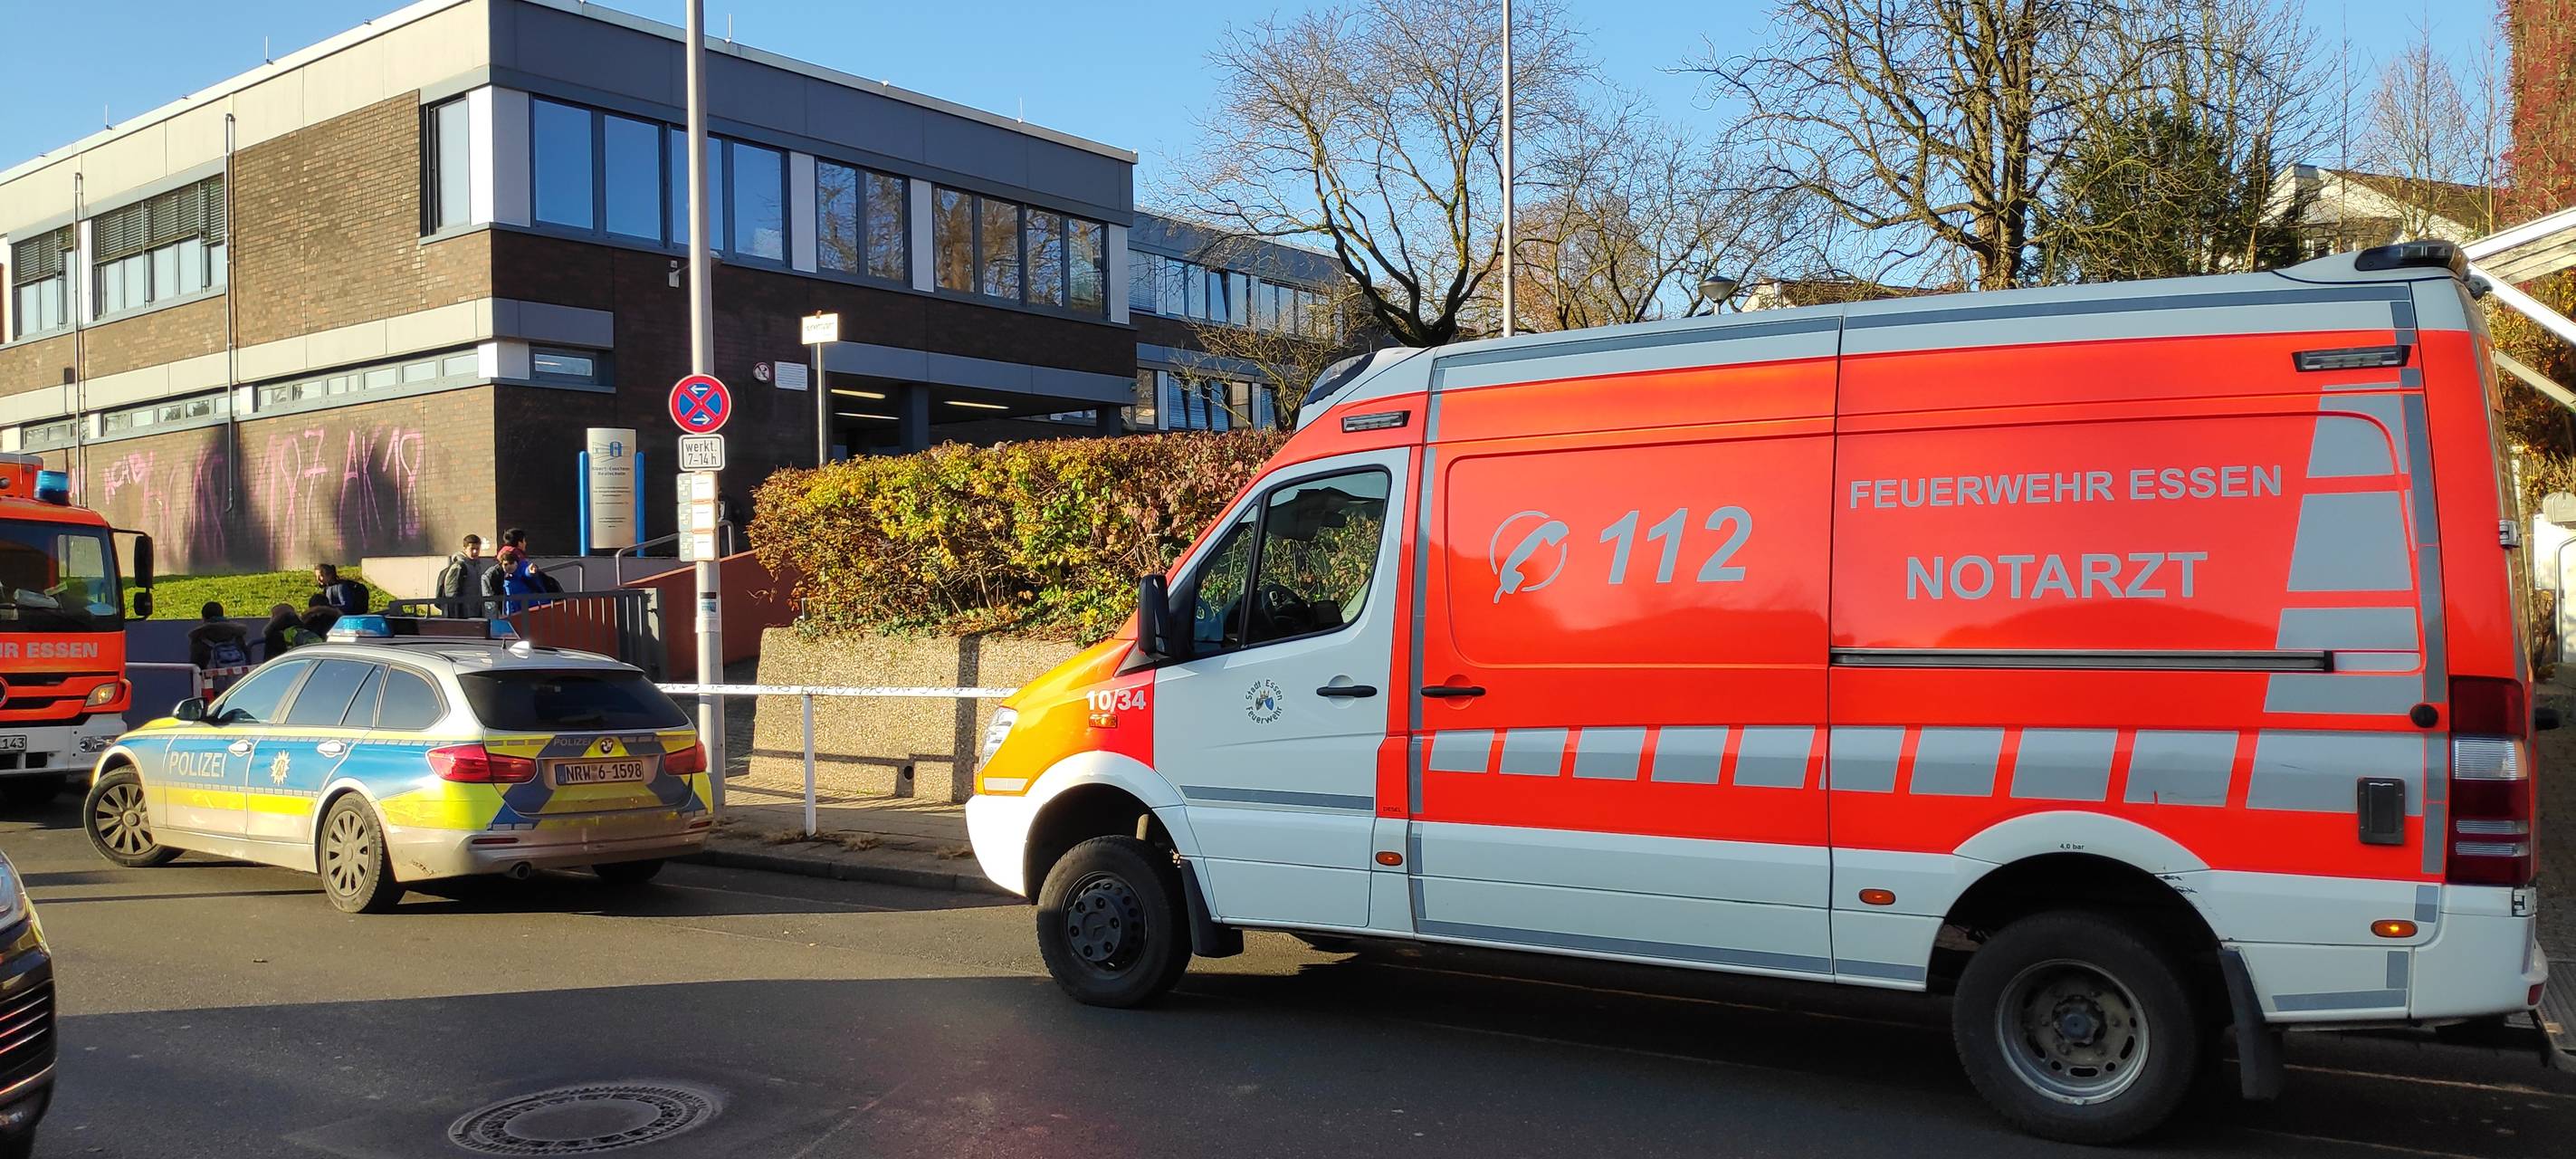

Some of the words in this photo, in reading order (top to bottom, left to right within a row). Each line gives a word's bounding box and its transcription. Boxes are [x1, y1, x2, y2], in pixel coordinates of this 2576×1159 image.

[685, 439, 718, 453] werkt.
[711, 453, 718, 465] h
[1849, 469, 2114, 510] FEUERWEHR
[2128, 465, 2283, 501] ESSEN
[1598, 504, 1753, 585] 112
[1904, 550, 2209, 601] NOTARZT
[26, 642, 99, 658] ESSEN
[1245, 680, 1262, 701] Stadt
[1264, 678, 1283, 701] Essen
[1085, 689, 1147, 714] 10/34
[1245, 705, 1283, 724] Feuerwehr
[0, 737, 24, 750] 143
[168, 751, 228, 778] POLIZEI
[565, 764, 592, 782] NRW
[597, 762, 643, 780] 6-1598
